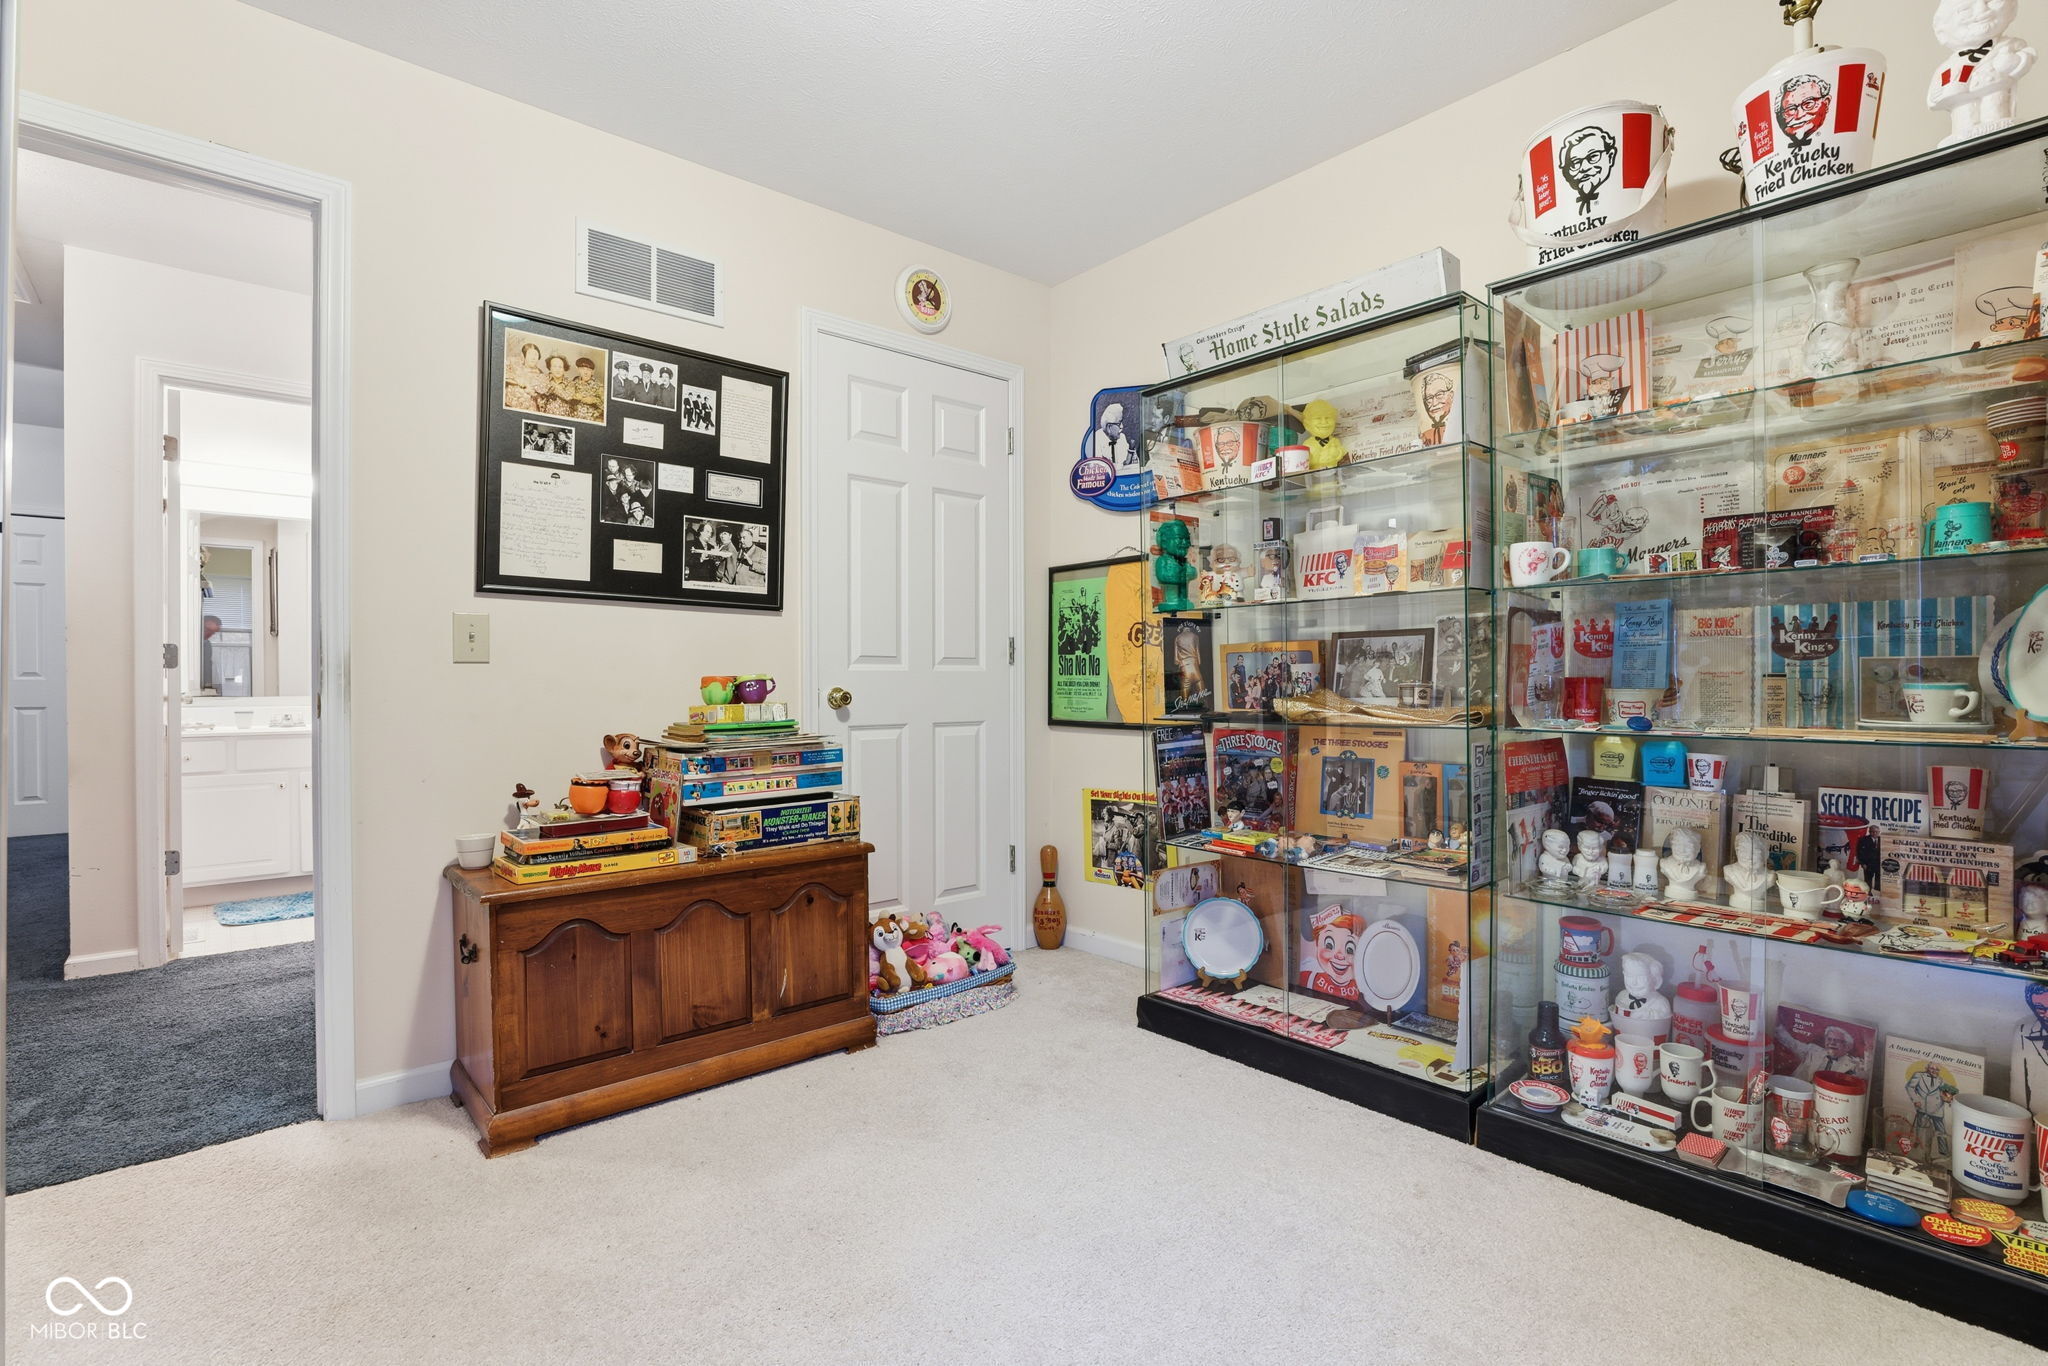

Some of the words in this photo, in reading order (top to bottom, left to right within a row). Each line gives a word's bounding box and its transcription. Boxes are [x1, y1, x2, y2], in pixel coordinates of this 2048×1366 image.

[1764, 143, 1840, 179] Kentucky
[1755, 174, 1785, 201] Fried
[1790, 160, 1854, 184] Chicken
[1871, 294, 1893, 305] This
[1896, 290, 1908, 300] Is
[1910, 287, 1924, 296] To
[1209, 338, 1259, 361] Home
[1262, 313, 1310, 346] Style
[1316, 291, 1385, 327] Salads
[1893, 318, 1929, 329] OFFICIAL
[1880, 328, 1905, 338] GOOD
[1883, 334, 1910, 347] Jerry's
[1906, 339, 1929, 348] CLUB
[1351, 449, 1377, 462] Kentucky
[1379, 448, 1394, 457] Fried
[1789, 450, 1828, 462] Manners
[1079, 464, 1108, 476] Chicken
[1077, 480, 1106, 489] Famous
[1210, 474, 1249, 487] Kentucky
[1938, 476, 1967, 491] You'll
[1953, 484, 1976, 495] enjoy
[1627, 535, 1691, 563] Manners
[1303, 571, 1336, 587] KFC
[1877, 620, 1910, 631] Kentucky
[1913, 618, 1932, 629] Fried
[1934, 618, 1965, 629] Chicken
[1128, 621, 1164, 648] GRE
[1580, 630, 1609, 643] Kenny
[1690, 629, 1742, 637] SANDWICH
[1779, 629, 1818, 644] Kenny
[1794, 640, 1834, 654] King's
[1058, 654, 1073, 676] Sha
[1075, 654, 1087, 676] Na
[1088, 654, 1100, 676] Na
[1156, 728, 1173, 741] FREE
[1219, 734, 1247, 752] THREE
[1245, 733, 1283, 755] STOOGES
[1313, 738, 1326, 746] THE
[1327, 738, 1350, 747] THREE
[1351, 739, 1389, 749] STOOGES
[1652, 794, 1719, 811] COLONEL
[1820, 792, 1868, 818] SECRET
[1871, 796, 1922, 824] RECIPE
[780, 806, 812, 816] MOTORIZED
[763, 811, 827, 827] MONSTER-MAKER
[1745, 814, 1769, 831] The
[1938, 813, 1976, 824] Kentucky
[1933, 820, 1949, 829] Fried
[1951, 822, 1981, 832] Chicken
[1893, 839, 1921, 847] ENJOY
[1924, 842, 1956, 850] WHOLE
[536, 855, 547, 863] The
[548, 853, 569, 862] Beverly
[1888, 851, 1946, 863] CONVENIENT
[1950, 857, 2000, 868] GRINDERS
[1923, 849, 1951, 857] THEIR
[549, 864, 579, 878] Mighty
[578, 862, 602, 873] Mouse
[1316, 977, 1335, 994] BIG
[1673, 1014, 1703, 1027] SUPER
[1712, 1044, 1745, 1061] Kentucky
[1531, 1061, 1563, 1074] BBQ
[1595, 1074, 1608, 1082] Fried
[1616, 1104, 1635, 1114] KFC
[1820, 1117, 1849, 1126] READY
[1964, 1143, 2005, 1163] KFC
[1969, 1160, 1995, 1175] Come
[1997, 1167, 2018, 1177] Back
[1979, 1158, 2009, 1171] Coffee
[1985, 1170, 2004, 1181] Cup
[1924, 1215, 1987, 1235] Chicken
[1930, 1223, 1984, 1241] Littles
